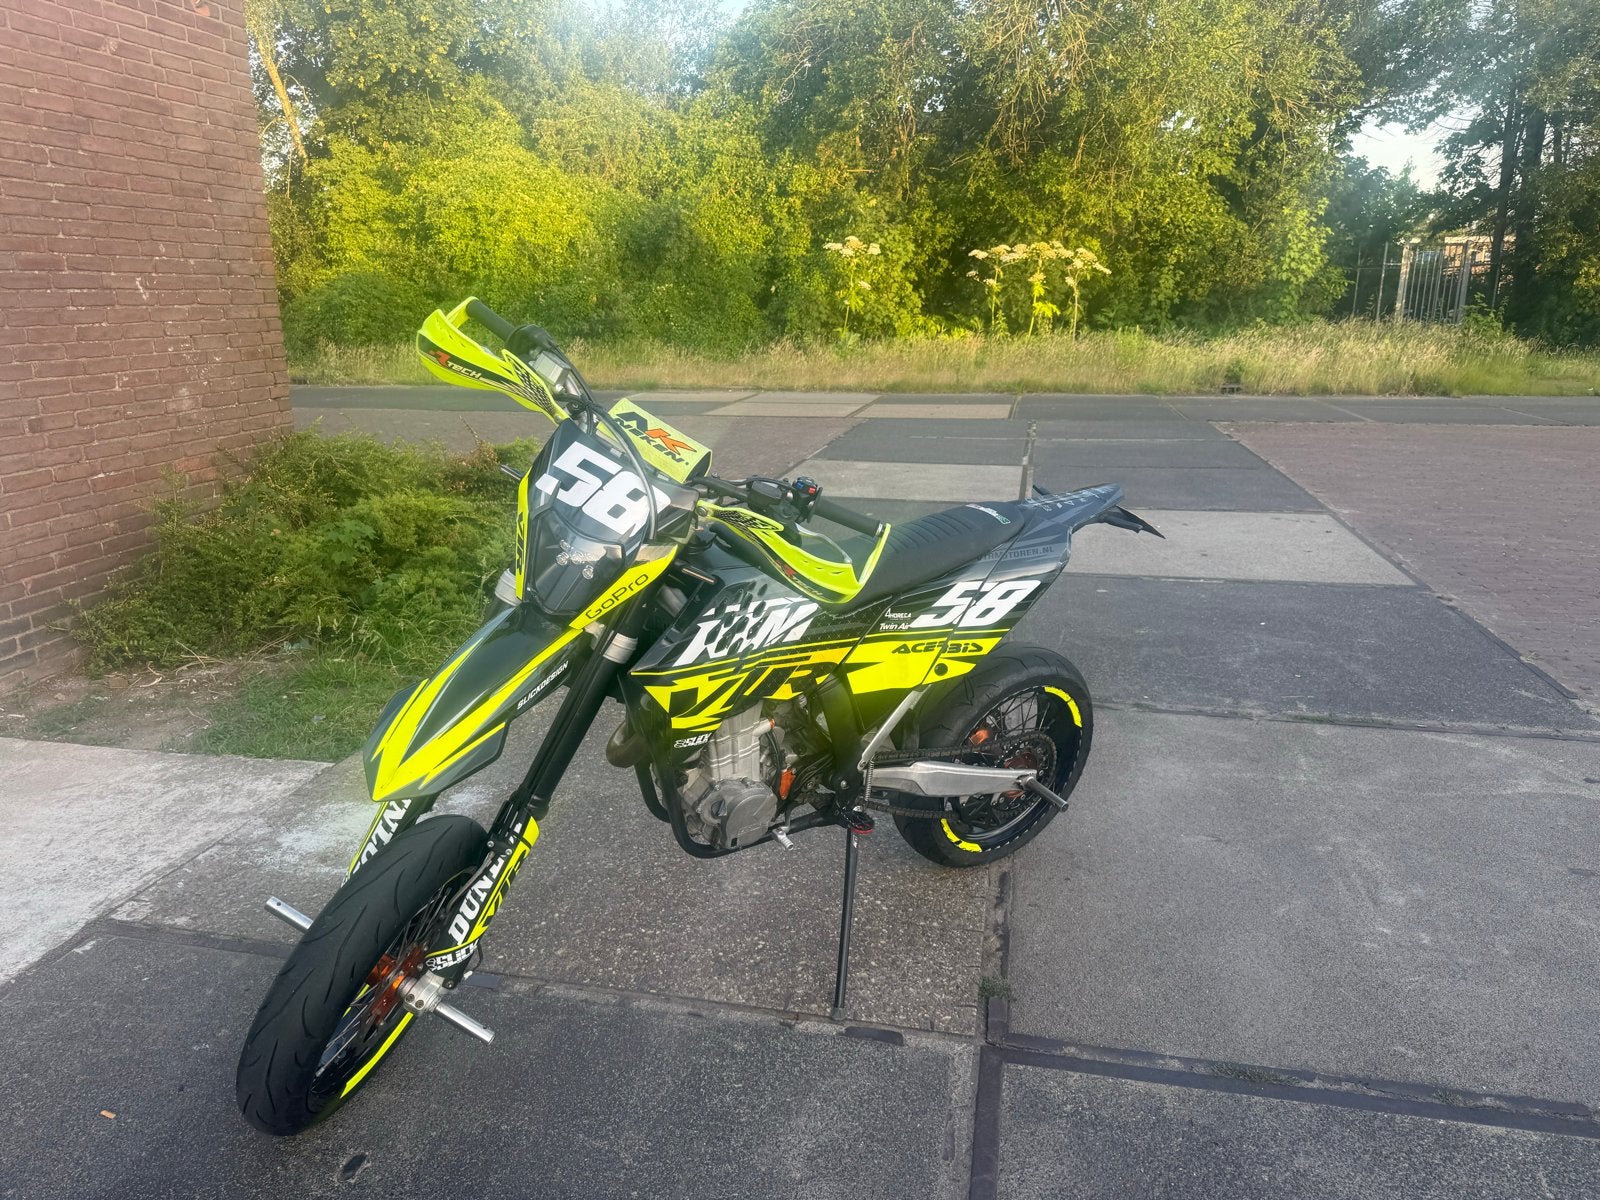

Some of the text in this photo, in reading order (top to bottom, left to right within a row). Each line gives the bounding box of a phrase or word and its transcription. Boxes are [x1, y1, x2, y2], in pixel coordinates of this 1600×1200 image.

[535, 440, 671, 537] 58
[586, 573, 649, 620] GoPro
[909, 579, 1041, 628] 58
[672, 597, 819, 667] KTM
[880, 622, 898, 631] Twin
